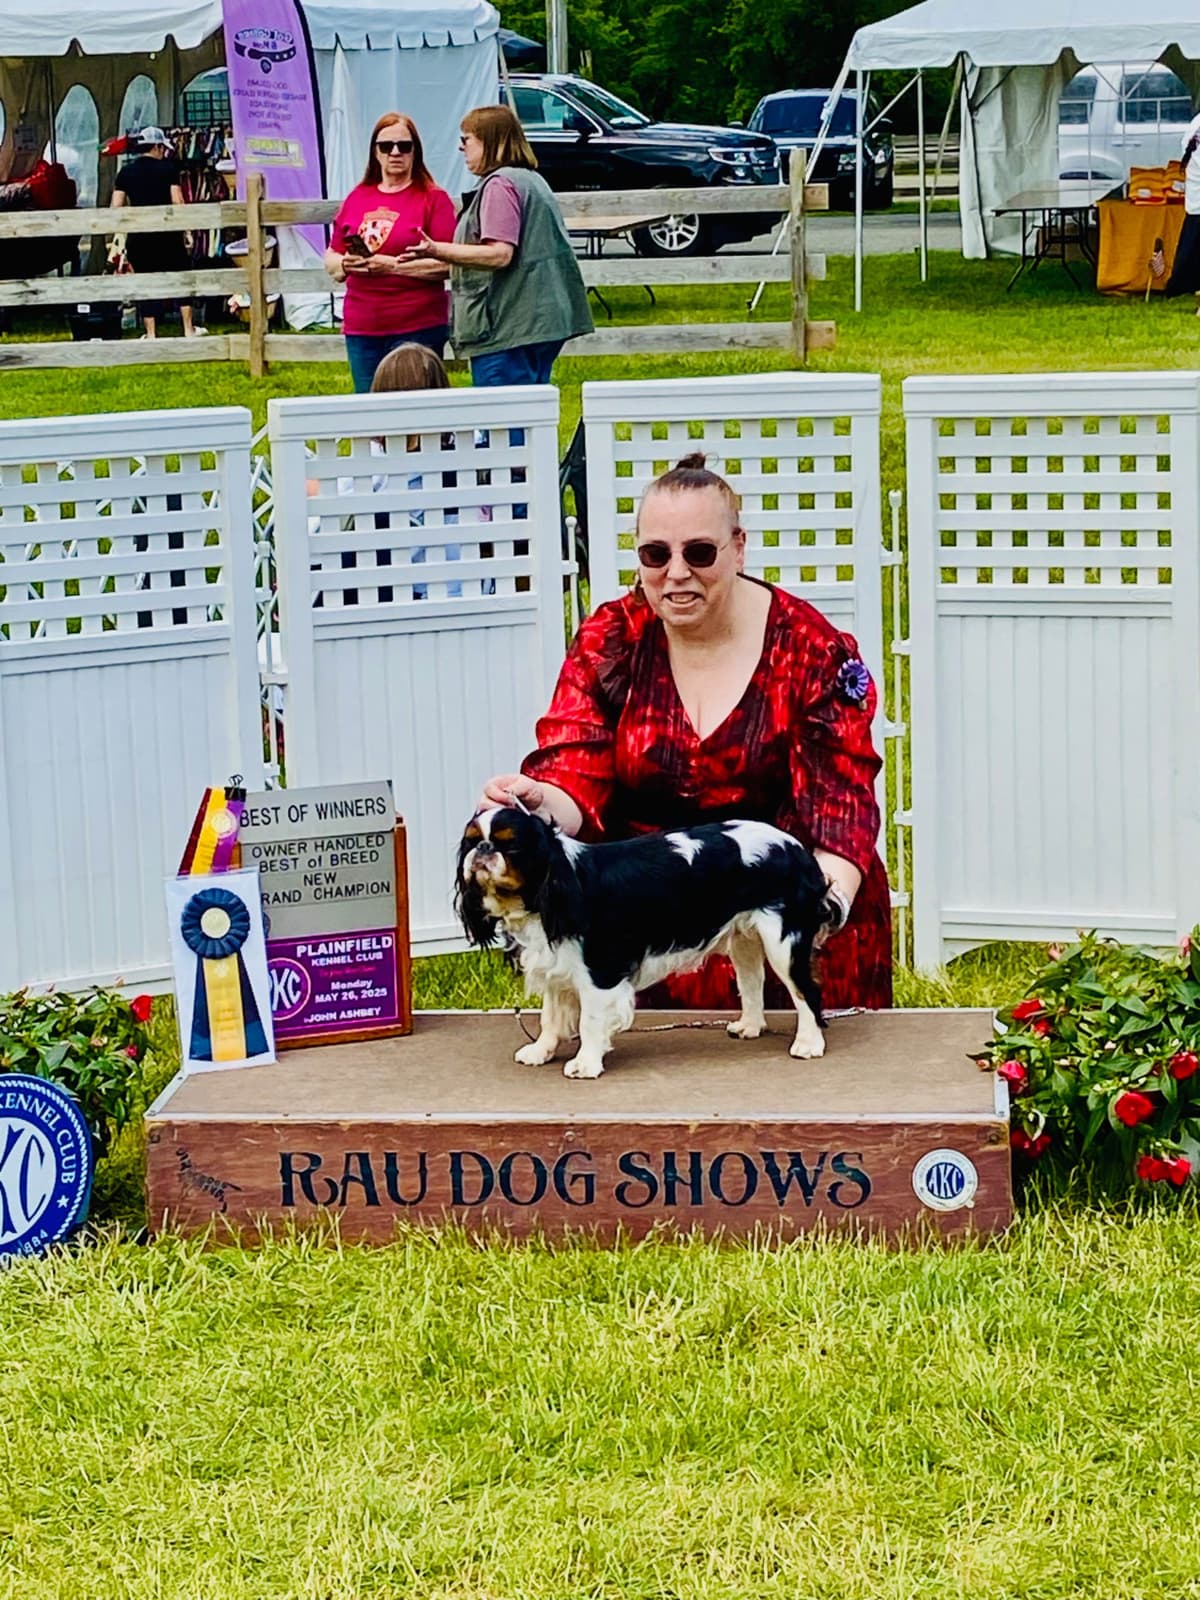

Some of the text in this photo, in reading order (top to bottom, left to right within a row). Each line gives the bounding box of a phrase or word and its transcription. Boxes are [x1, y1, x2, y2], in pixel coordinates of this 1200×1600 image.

[239, 796, 387, 828] BEST OF WINNERS
[251, 834, 386, 859] OWNER HANDLED
[259, 859, 298, 873] BEST
[330, 849, 380, 866] BREED
[303, 872, 337, 887] NEW
[261, 880, 391, 905] RAND CHAMPION
[296, 935, 393, 958] PLAINFIELD
[312, 951, 384, 967] KENNEL CLUB
[269, 967, 302, 1012] KC
[315, 993, 338, 1004] MAY
[361, 988, 387, 999] 2025
[331, 979, 372, 991] Monday
[309, 1011, 337, 1023] JOHN
[55, 1128, 77, 1185] CLUB
[278, 1150, 428, 1208] RAU
[449, 1150, 597, 1208] DOG
[615, 1150, 871, 1209] SHOWS
[927, 1163, 964, 1199] AKC
